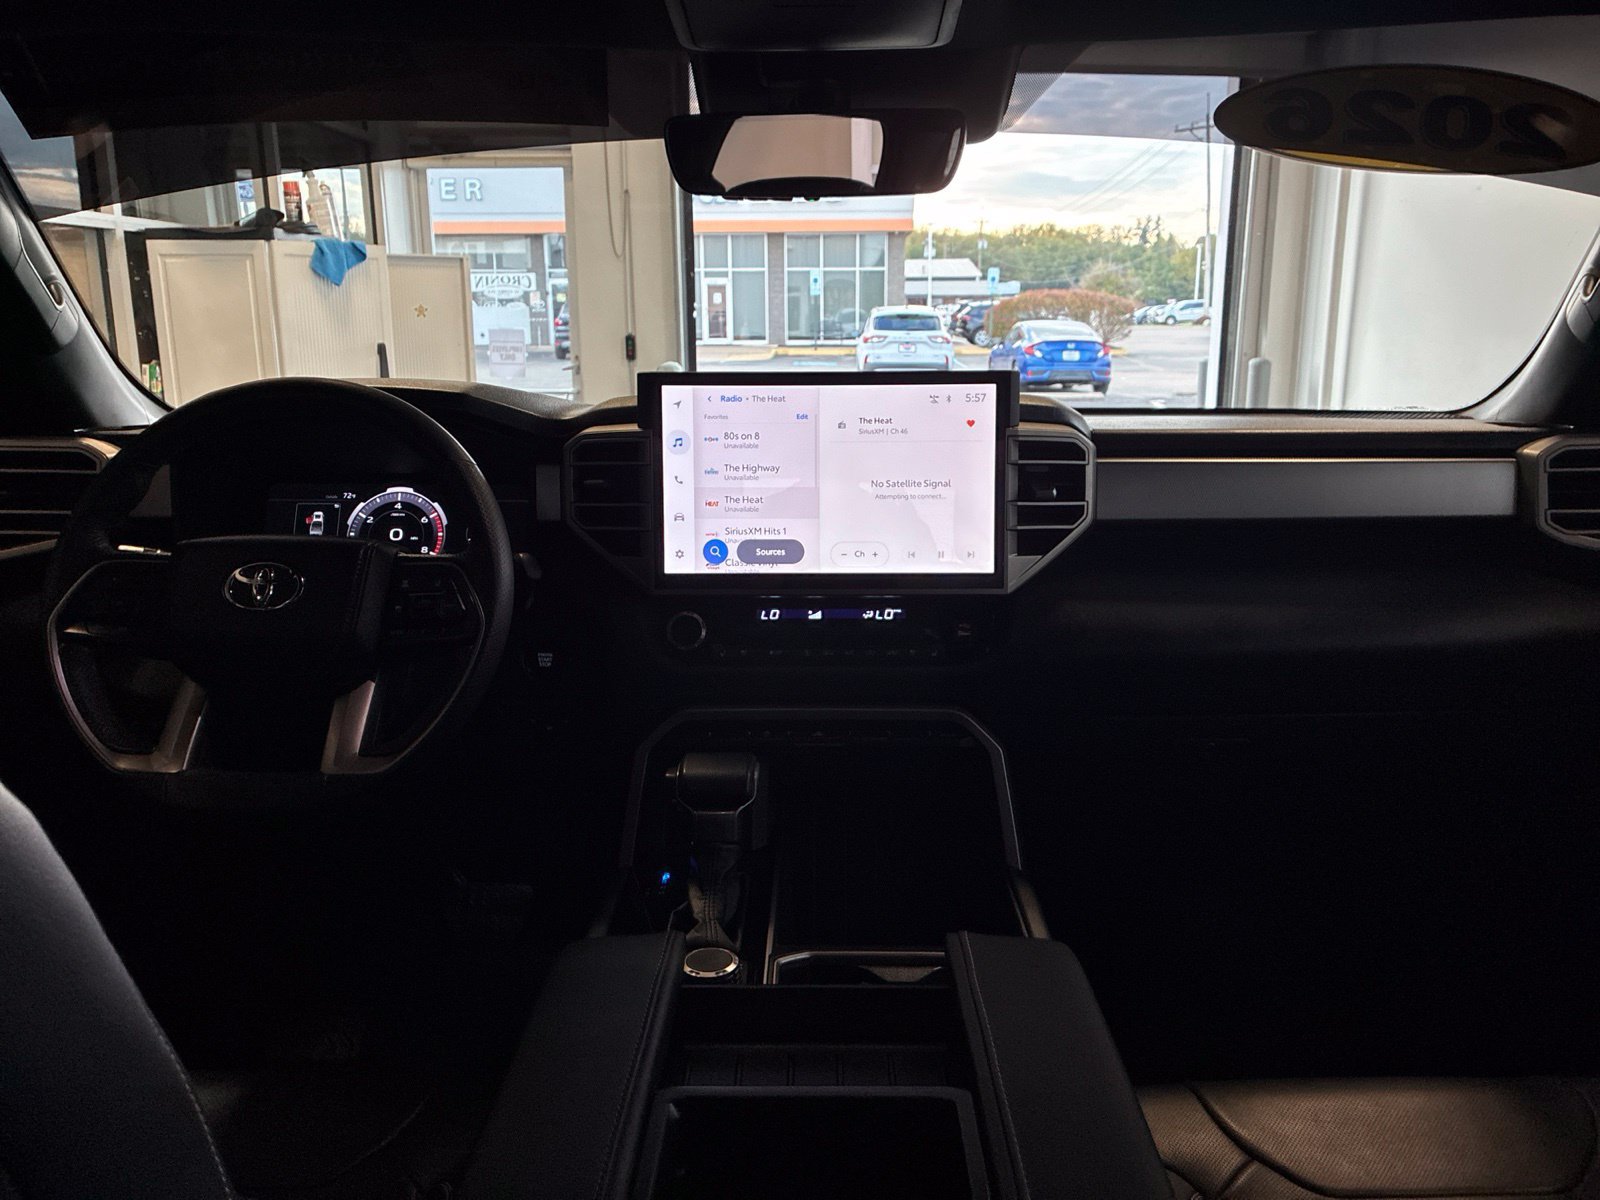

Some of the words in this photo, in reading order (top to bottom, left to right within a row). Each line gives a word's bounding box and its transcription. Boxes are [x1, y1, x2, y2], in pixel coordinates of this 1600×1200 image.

[720, 395, 743, 403] Radio
[752, 395, 767, 403] The
[767, 395, 786, 403] Heat
[965, 393, 987, 403] 5:57
[858, 417, 873, 425] The
[873, 417, 893, 425] Heat
[723, 432, 739, 440] 80s
[753, 432, 760, 440] 8
[723, 442, 760, 450] Unavailable
[723, 464, 741, 472] The
[741, 464, 781, 475] Highway
[870, 479, 884, 488] No
[885, 479, 923, 488] Satellite
[923, 479, 952, 490] Signal
[724, 495, 741, 504] The
[741, 495, 764, 504] Heat
[874, 493, 909, 501] Attempting
[394, 502, 403, 510] 4
[389, 528, 403, 541] 0
[724, 526, 763, 536] SiriusXM
[763, 527, 781, 536] Hits
[782, 527, 788, 535] 1
[421, 546, 429, 554] 8
[755, 548, 786, 557] Sources
[854, 550, 866, 558] Ch
[760, 609, 780, 620] LO
